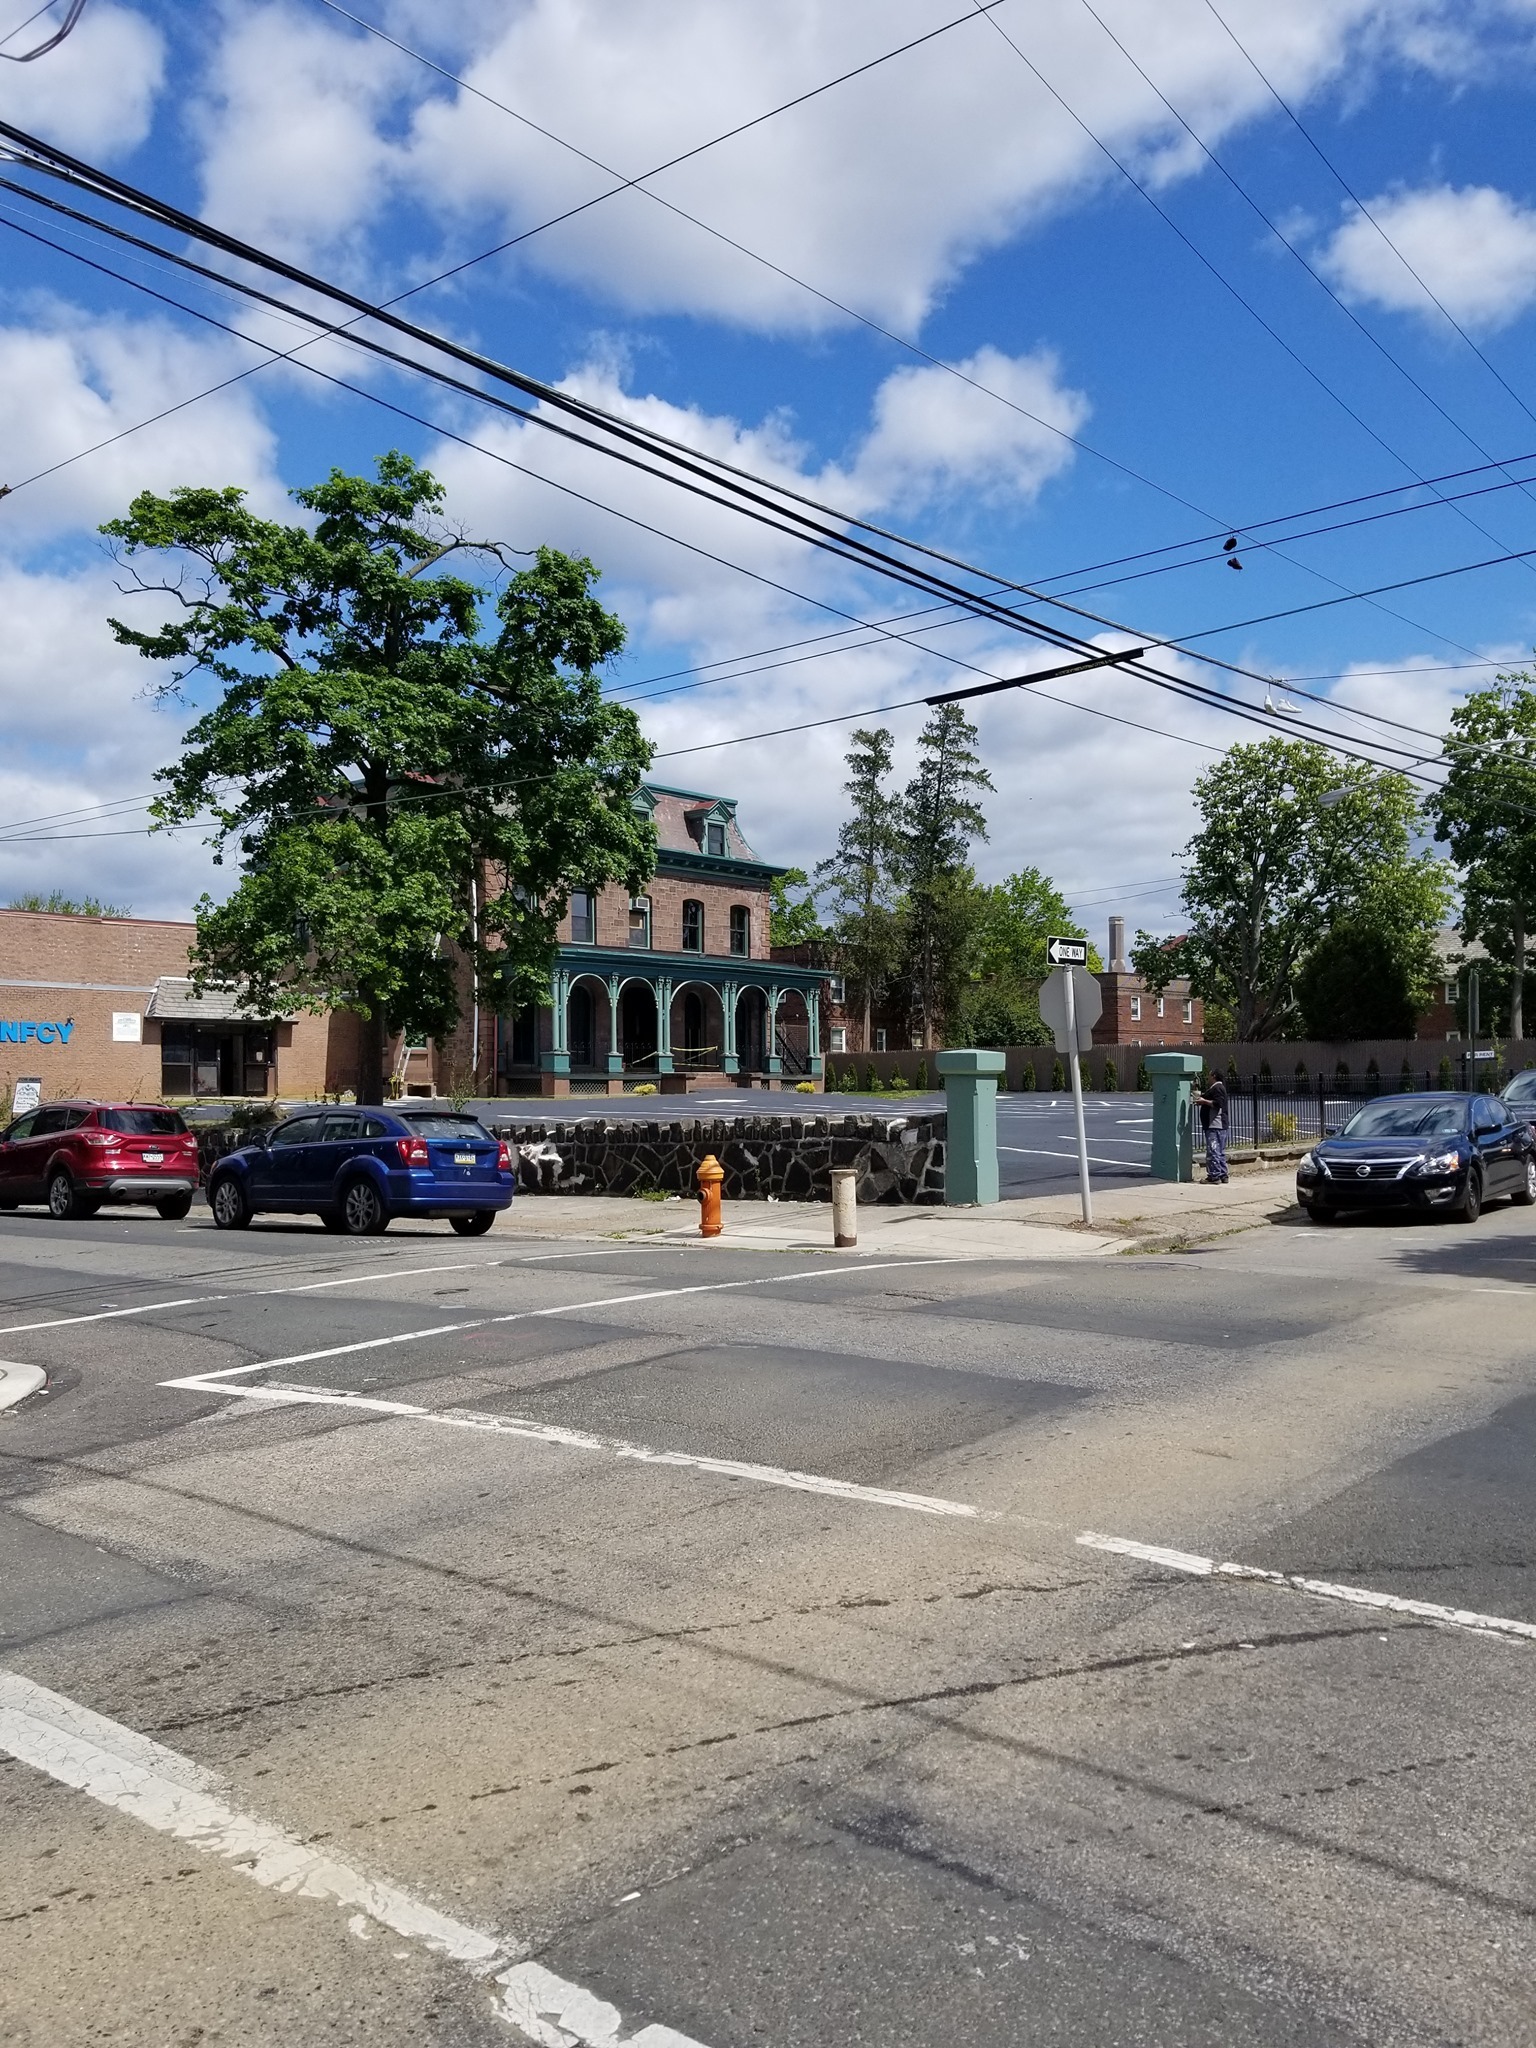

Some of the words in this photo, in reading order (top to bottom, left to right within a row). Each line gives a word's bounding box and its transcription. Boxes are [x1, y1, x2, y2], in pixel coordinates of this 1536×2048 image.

[1058, 946, 1070, 957] ONE
[1071, 947, 1083, 958] WAY
[0, 1021, 73, 1044] NFCY
